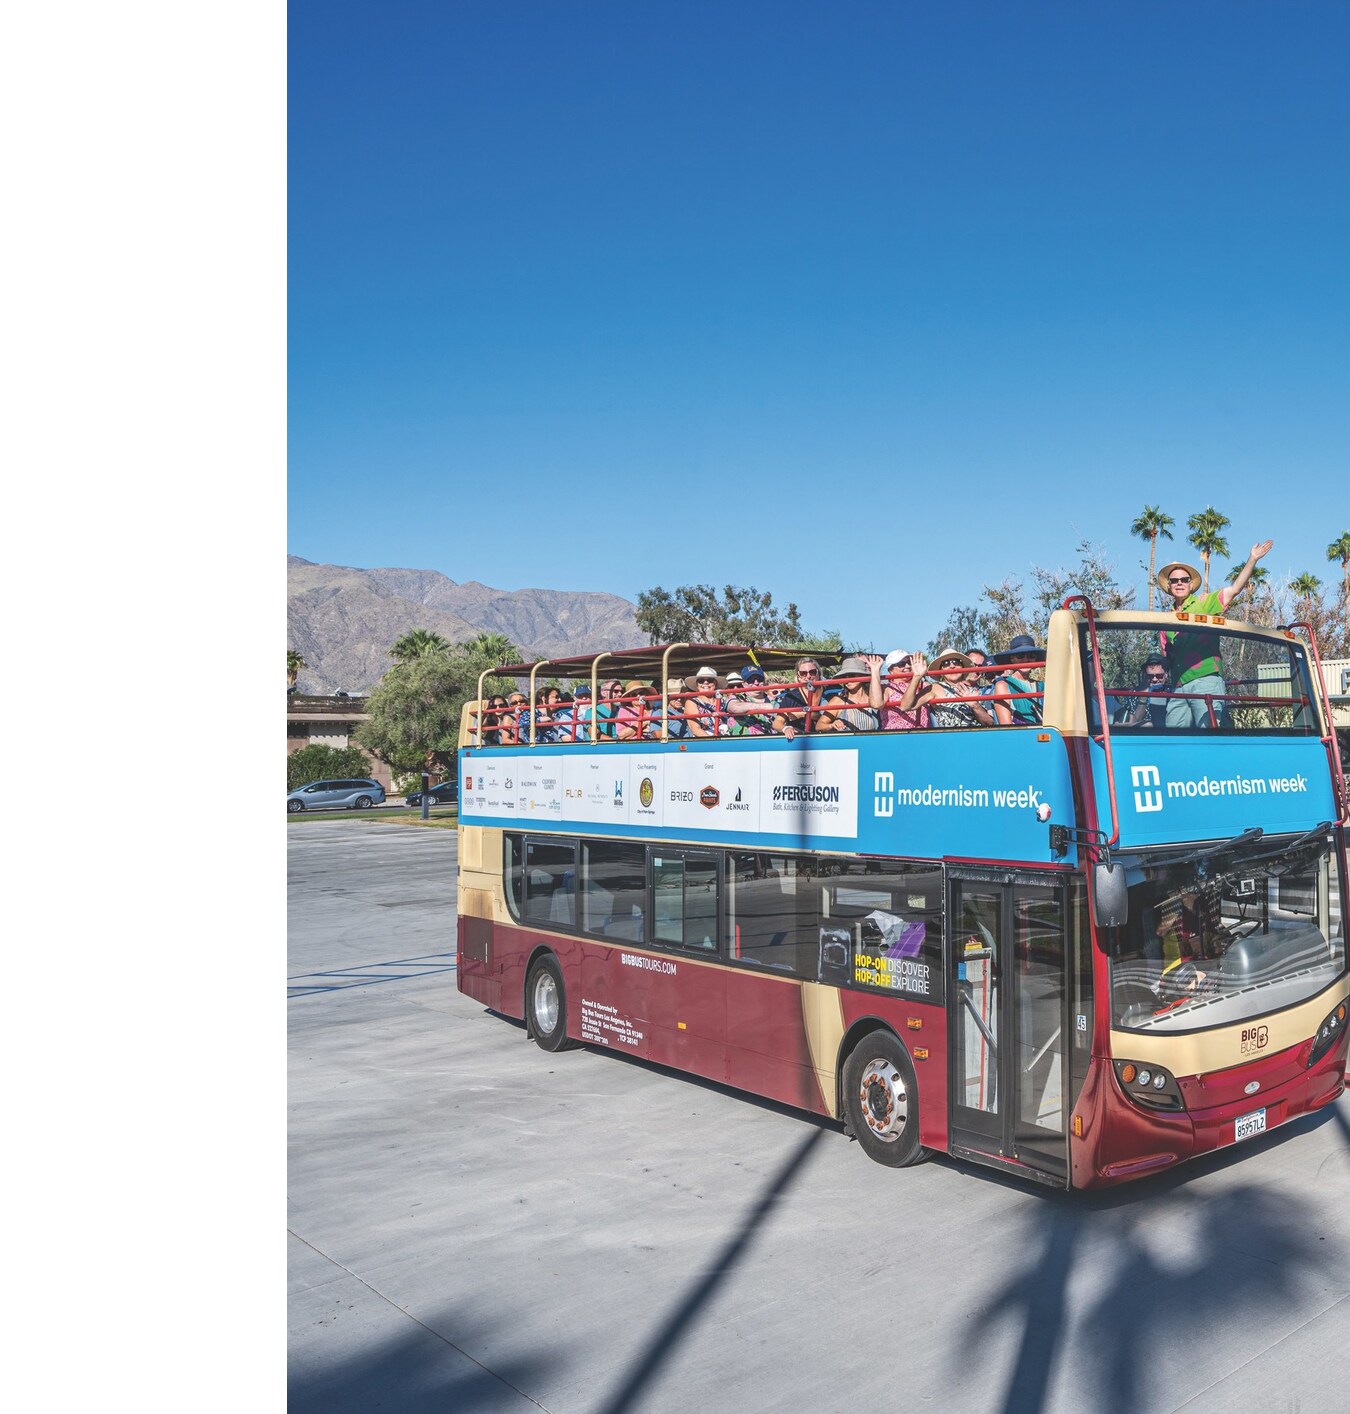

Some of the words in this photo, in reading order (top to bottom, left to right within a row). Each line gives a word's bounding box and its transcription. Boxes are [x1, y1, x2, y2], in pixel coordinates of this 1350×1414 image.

[782, 786, 839, 802] FERGUSON
[898, 784, 988, 807] modernism
[1167, 775, 1266, 798] modernism
[670, 791, 693, 802] BRIZO
[773, 803, 781, 811] Bath,
[784, 803, 798, 811] Kitchen
[804, 804, 822, 814] Lighting
[823, 804, 839, 815] Gallery
[621, 953, 677, 975] BIGBUSTOURS.COM
[855, 953, 887, 971] HOP-ON
[888, 959, 930, 979] DISCOVER
[855, 968, 890, 987] HOP-OFF
[892, 975, 930, 995] EXPLORE
[582, 998, 593, 1008] Owned
[597, 1003, 612, 1013] Operated
[613, 1007, 618, 1015] by
[1242, 1028, 1257, 1042] BIG
[1241, 1040, 1256, 1053] BUS
[1238, 1117, 1264, 1137] 85957L2
